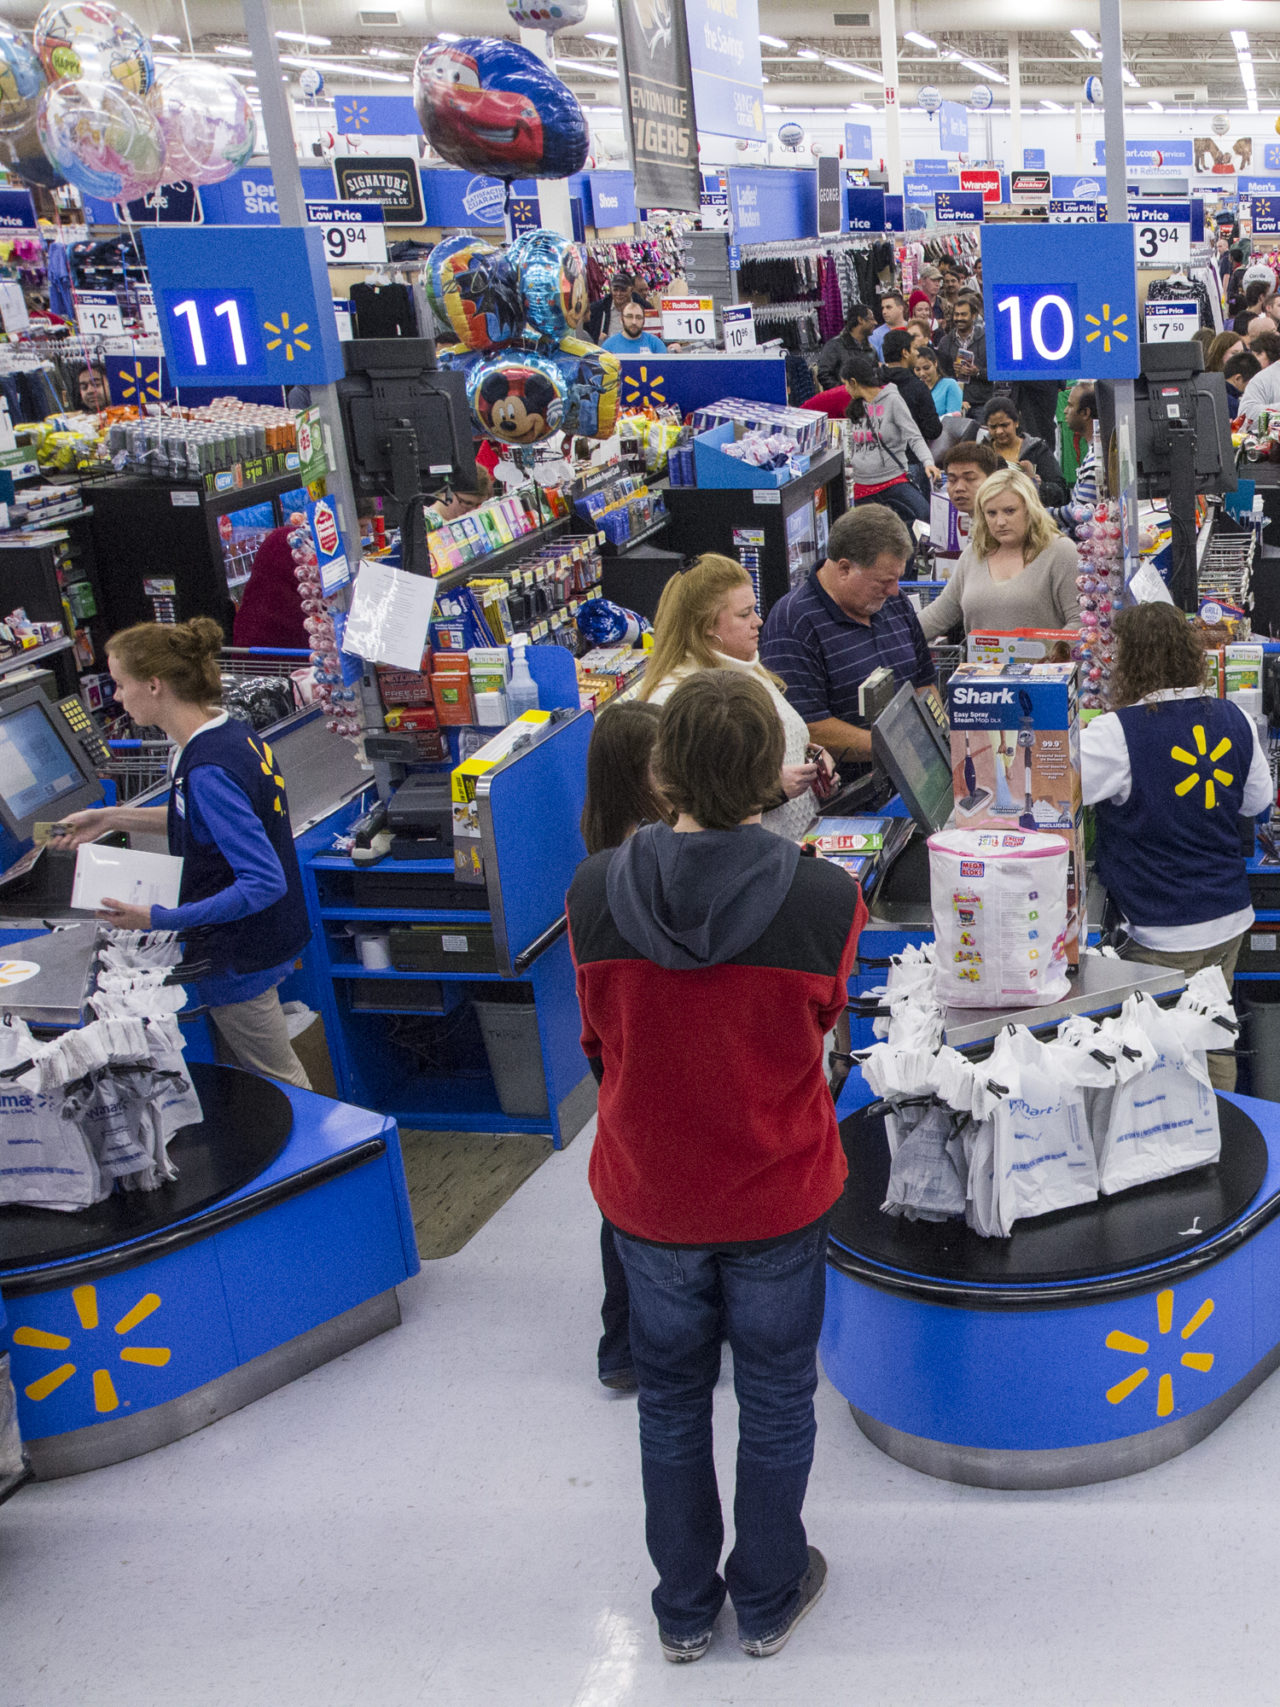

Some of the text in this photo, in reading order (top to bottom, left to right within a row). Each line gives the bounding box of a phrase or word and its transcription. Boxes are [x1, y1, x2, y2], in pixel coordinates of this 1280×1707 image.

[630, 86, 688, 120] ENTONVILLE
[633, 117, 691, 159] TIGERS
[1160, 150, 1186, 159] Services
[1140, 166, 1183, 176] Restrooms
[346, 174, 409, 193] SIGNATURE
[907, 183, 928, 191] Men's
[962, 179, 1000, 193] Wrangler
[1247, 181, 1276, 192] Men's
[819, 187, 840, 201] GEORGE
[143, 192, 169, 209] Lee
[599, 193, 618, 209] Shoes
[1063, 203, 1080, 213] Low
[309, 209, 363, 222] Low Price
[938, 211, 975, 221] Low Price
[1127, 210, 1170, 222] ow Price
[848, 217, 872, 230] rice
[1255, 220, 1277, 231] Low
[730, 246, 738, 258] E
[729, 259, 742, 270] 33
[95, 296, 107, 305] Price
[671, 300, 700, 311] Rollback
[1156, 306, 1185, 316] Low Price
[172, 299, 248, 366] 11
[996, 293, 1075, 362] 10
[216, 473, 234, 489] NEW
[472, 676, 488, 684] Save
[384, 689, 411, 698] FREE
[953, 687, 1016, 705] Shark
[953, 711, 990, 720] Easy Spray
[953, 716, 974, 724] Steam
[974, 717, 990, 725] Mop
[961, 869, 984, 877] BLOKS
